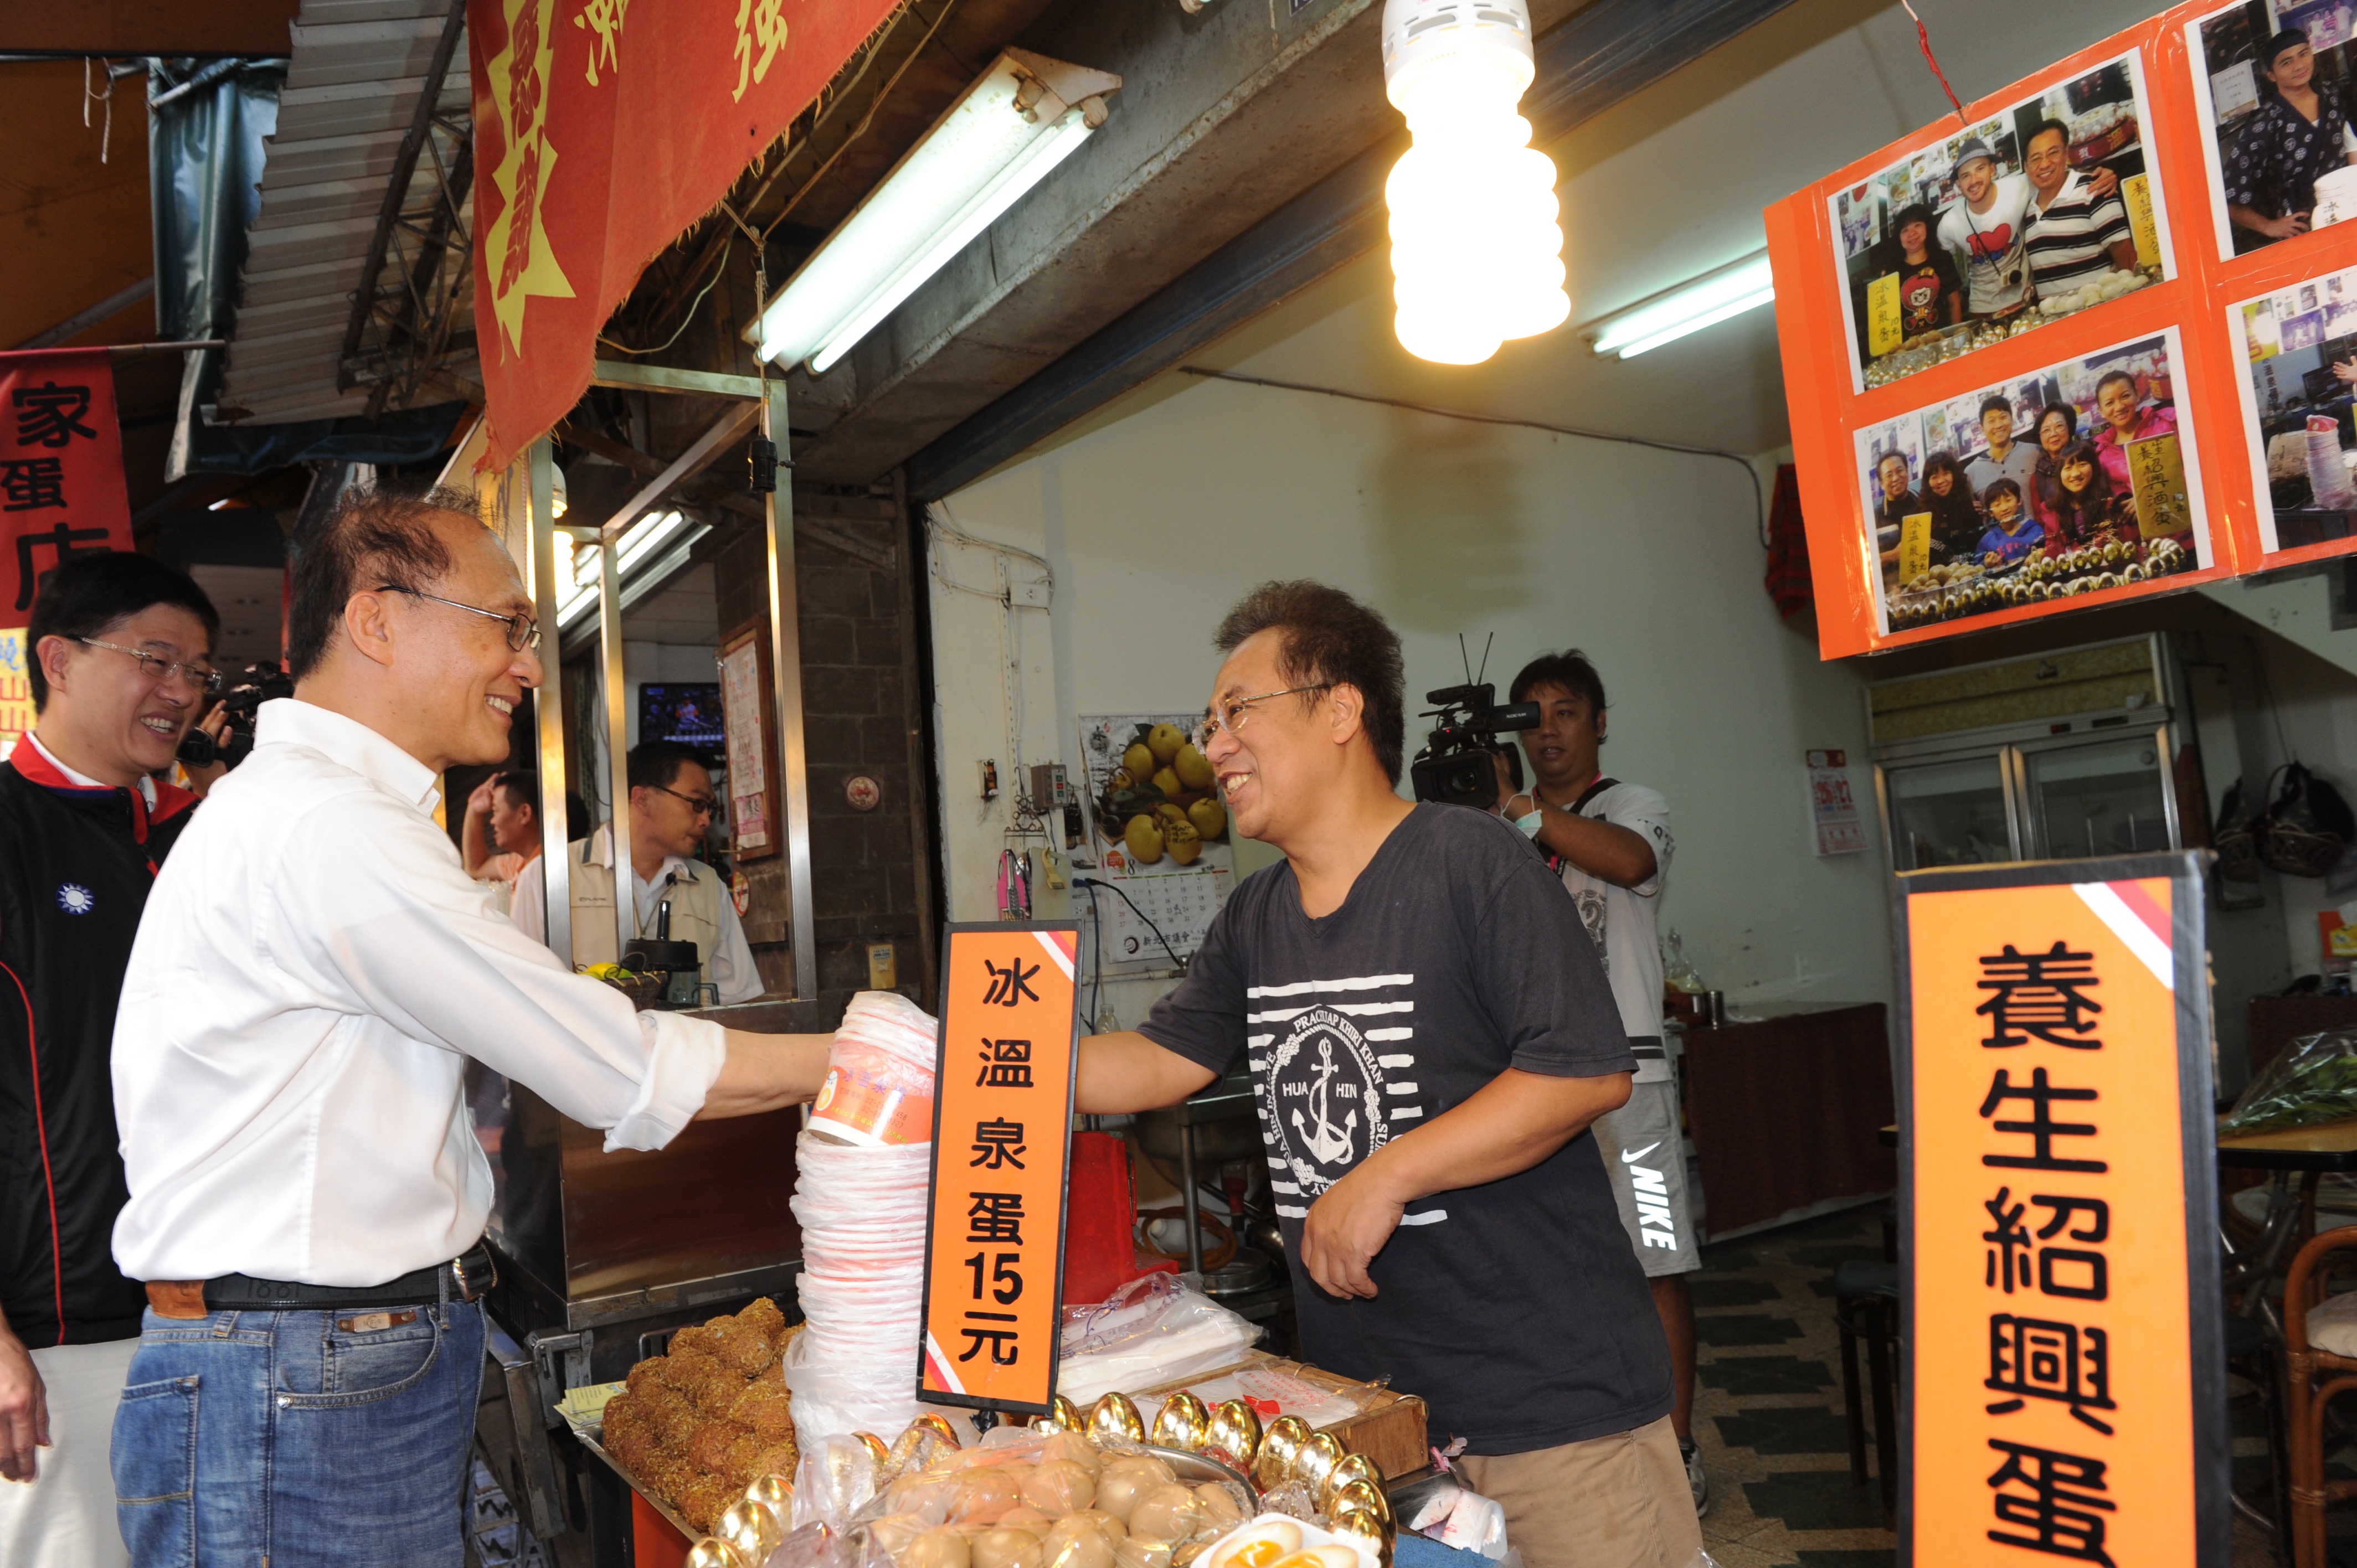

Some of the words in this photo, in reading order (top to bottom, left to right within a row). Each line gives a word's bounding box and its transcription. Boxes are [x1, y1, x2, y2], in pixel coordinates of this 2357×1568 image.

[1128, 859, 1135, 875] 8
[1293, 1010, 1340, 1033] PRACHUAP
[1339, 1018, 1363, 1048] KHIRI
[1359, 1043, 1385, 1085] KHAN
[1265, 1051, 1277, 1091] LOVE
[1283, 1081, 1309, 1097] HUA
[1336, 1083, 1357, 1098] HIN
[1267, 1094, 1274, 1110] IN
[1270, 1111, 1281, 1139] HIN
[959, 957, 1040, 1366] 冰溫泉蛋15元
[1629, 1165, 1677, 1251] NIKE
[1975, 940, 2118, 1568] 養生紹興蛋
